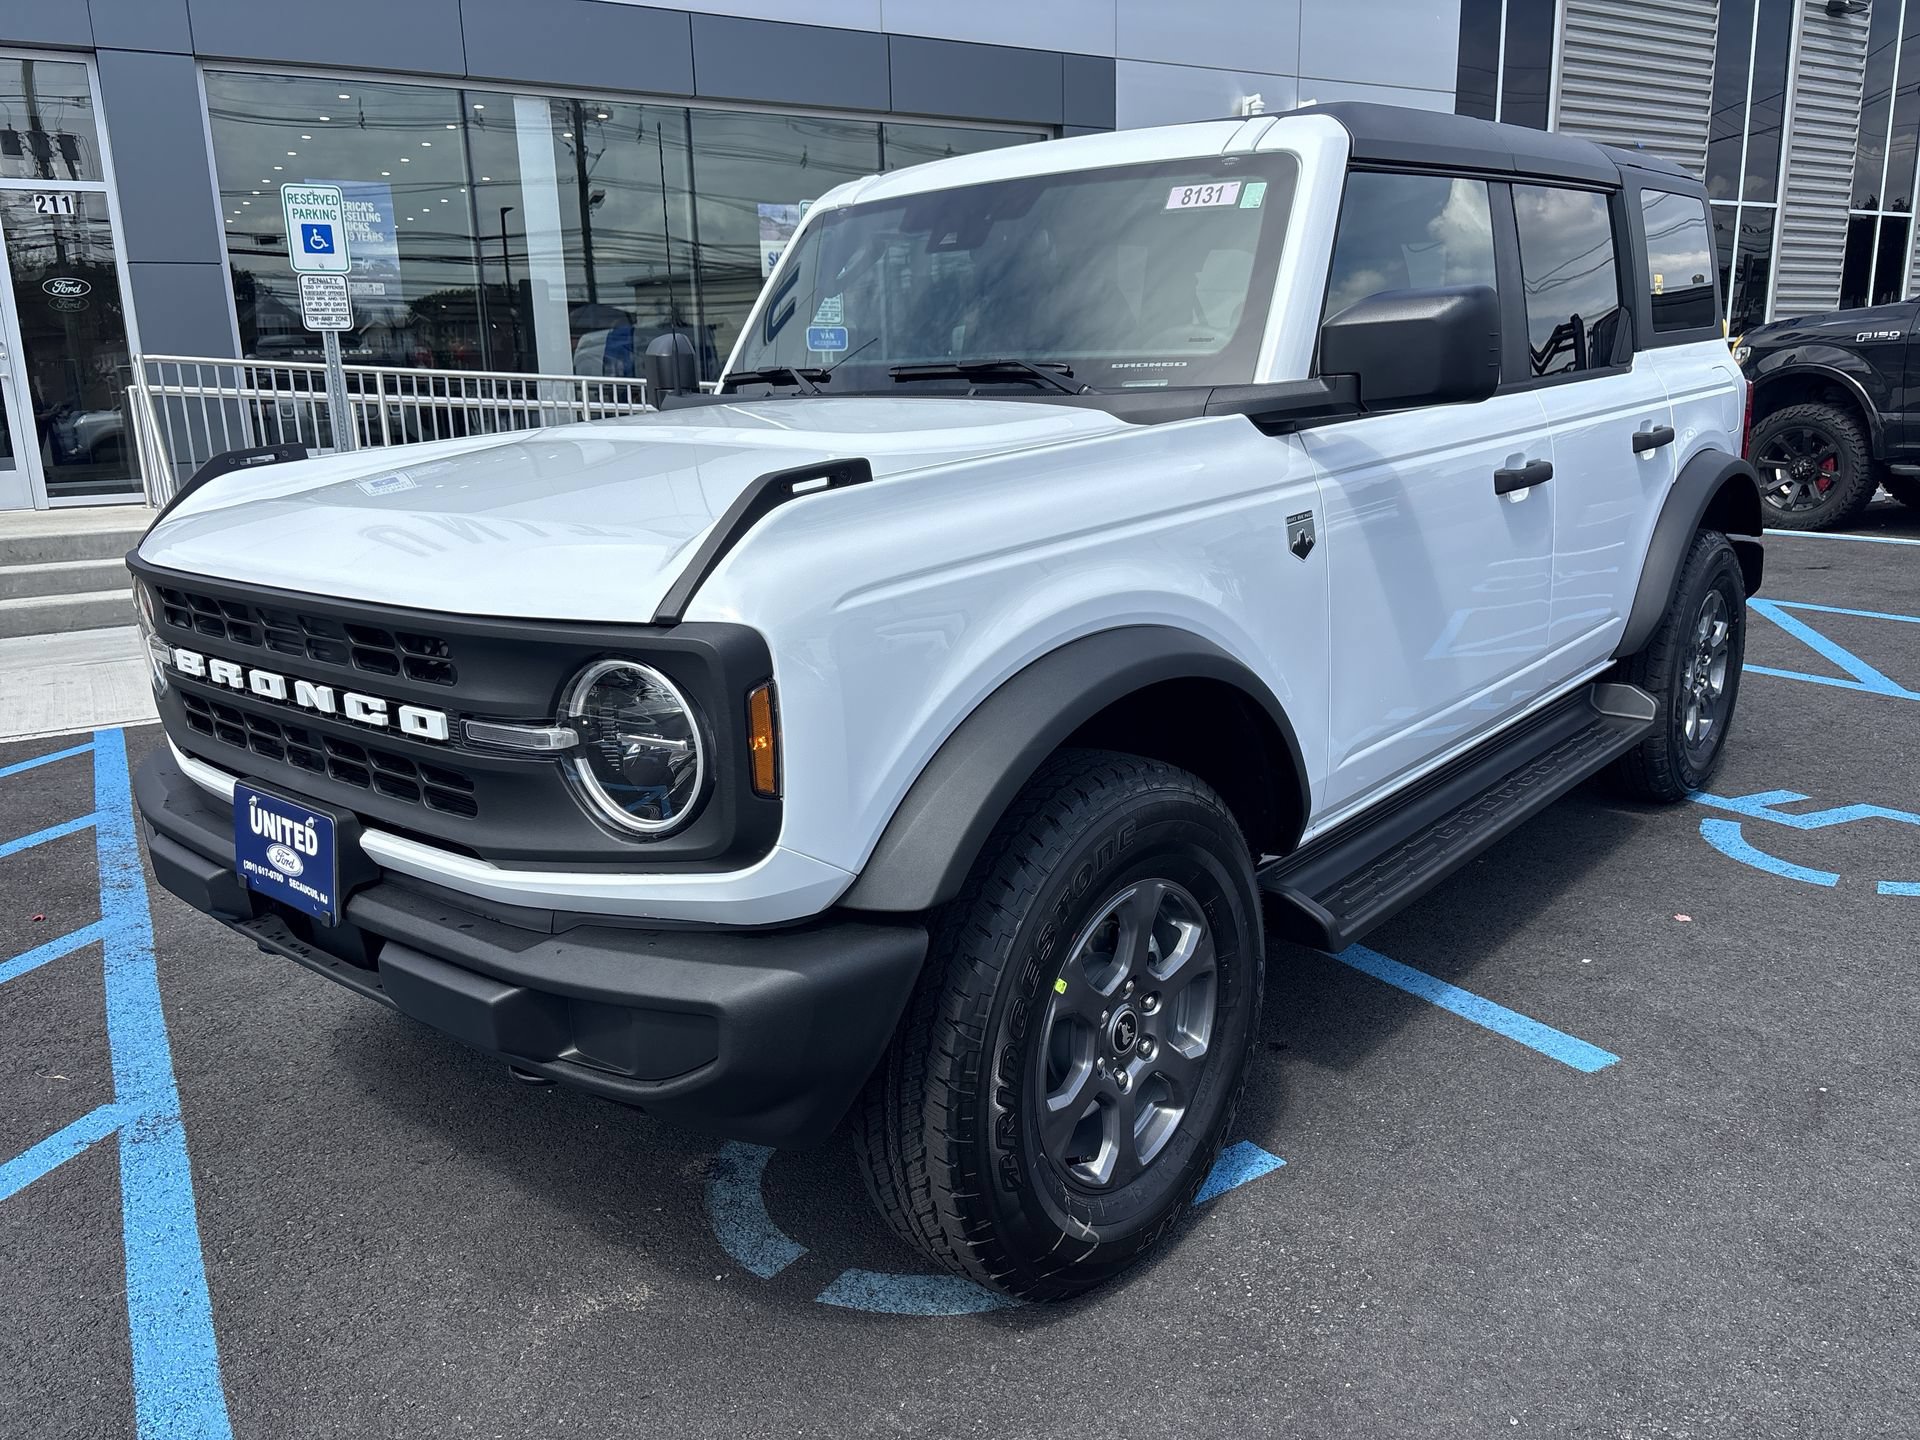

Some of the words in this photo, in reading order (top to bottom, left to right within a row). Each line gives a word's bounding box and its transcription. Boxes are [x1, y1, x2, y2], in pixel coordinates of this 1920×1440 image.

[287, 193, 339, 206] RESERVED
[1181, 185, 1225, 206] 8131
[35, 195, 72, 214] 211
[343, 201, 374, 212] ERICA'S
[292, 208, 337, 220] PARKING
[344, 212, 381, 223] -SELLING
[347, 221, 370, 232] UCKS
[356, 231, 384, 243] YEARS
[51, 280, 82, 294] Ford
[819, 332, 835, 340] VAN
[1111, 361, 1187, 369] BRONCO
[175, 647, 449, 741] BRONCO
[249, 804, 319, 857] UNITED
[275, 847, 296, 870] Ford
[243, 859, 258, 875] (201)
[258, 865, 284, 884] 617-0700
[288, 877, 320, 903] SECAUCUS,
[320, 892, 328, 905] NJ
[993, 819, 1138, 1193] BRIDGESTONE
